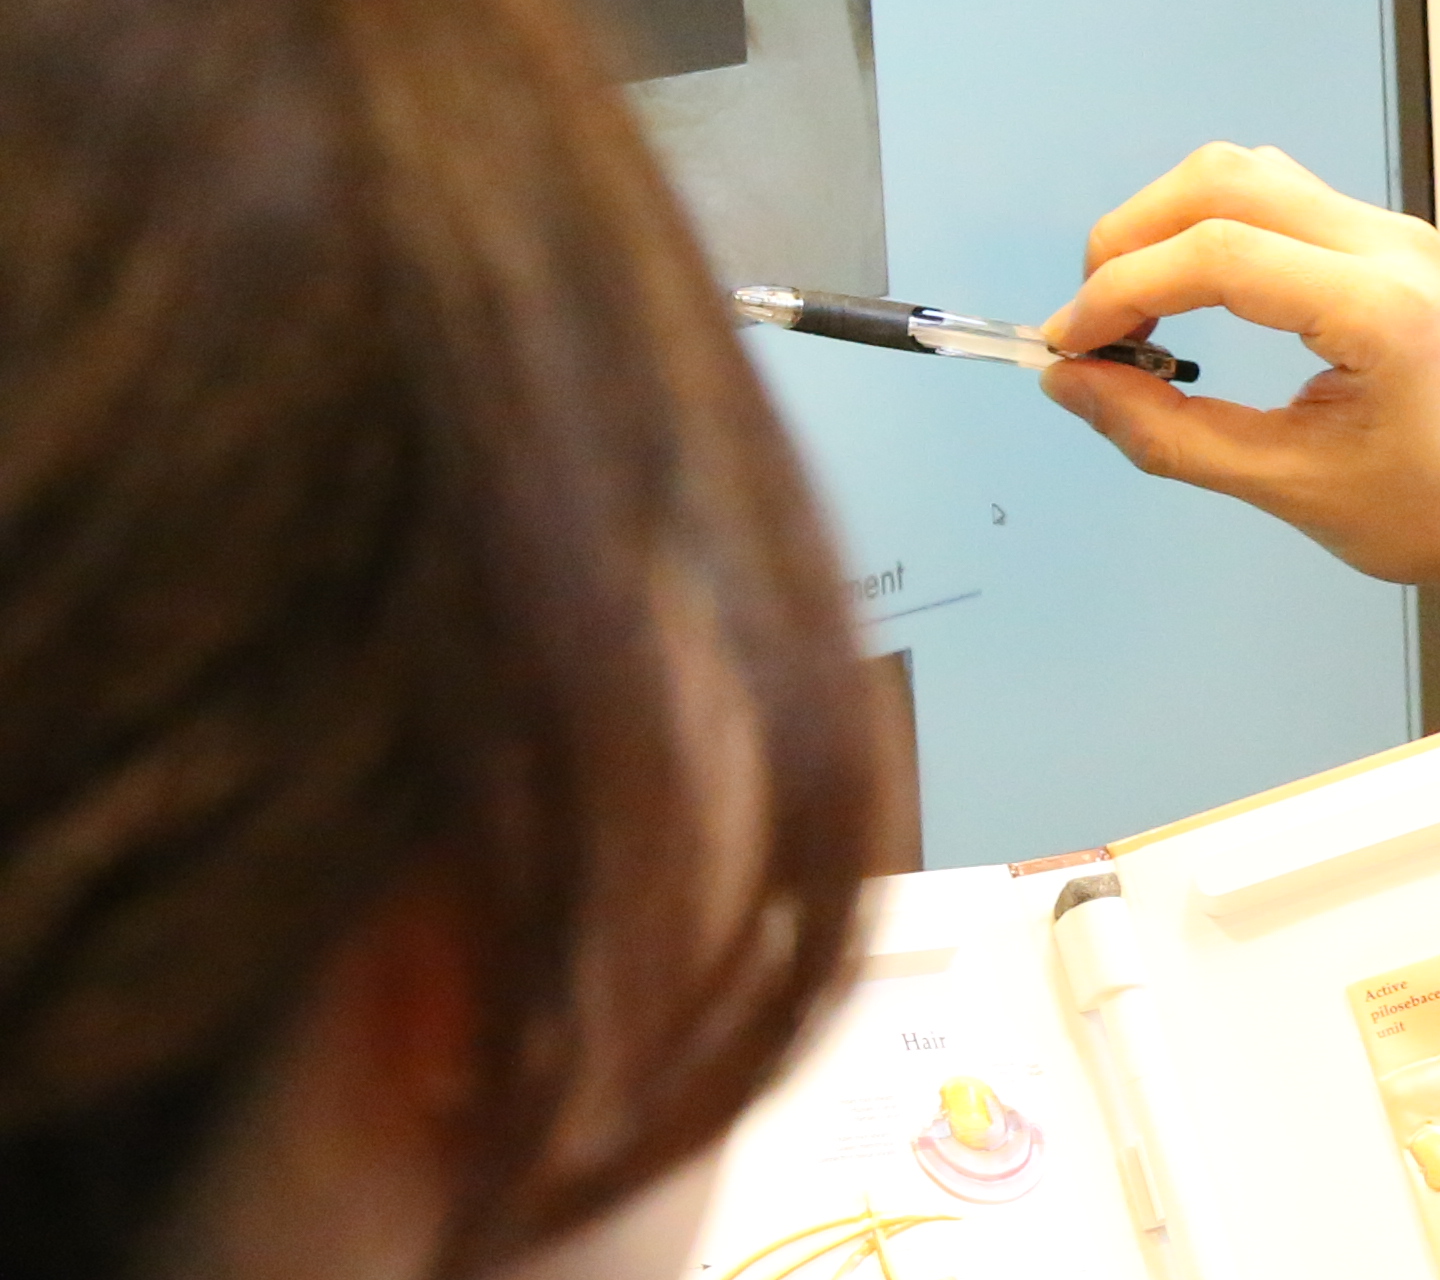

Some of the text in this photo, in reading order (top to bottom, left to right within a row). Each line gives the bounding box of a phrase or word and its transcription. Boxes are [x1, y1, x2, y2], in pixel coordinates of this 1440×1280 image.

[1363, 977, 1409, 1003] Active
[1376, 1019, 1407, 1039] unit
[901, 1031, 947, 1052] Hair
